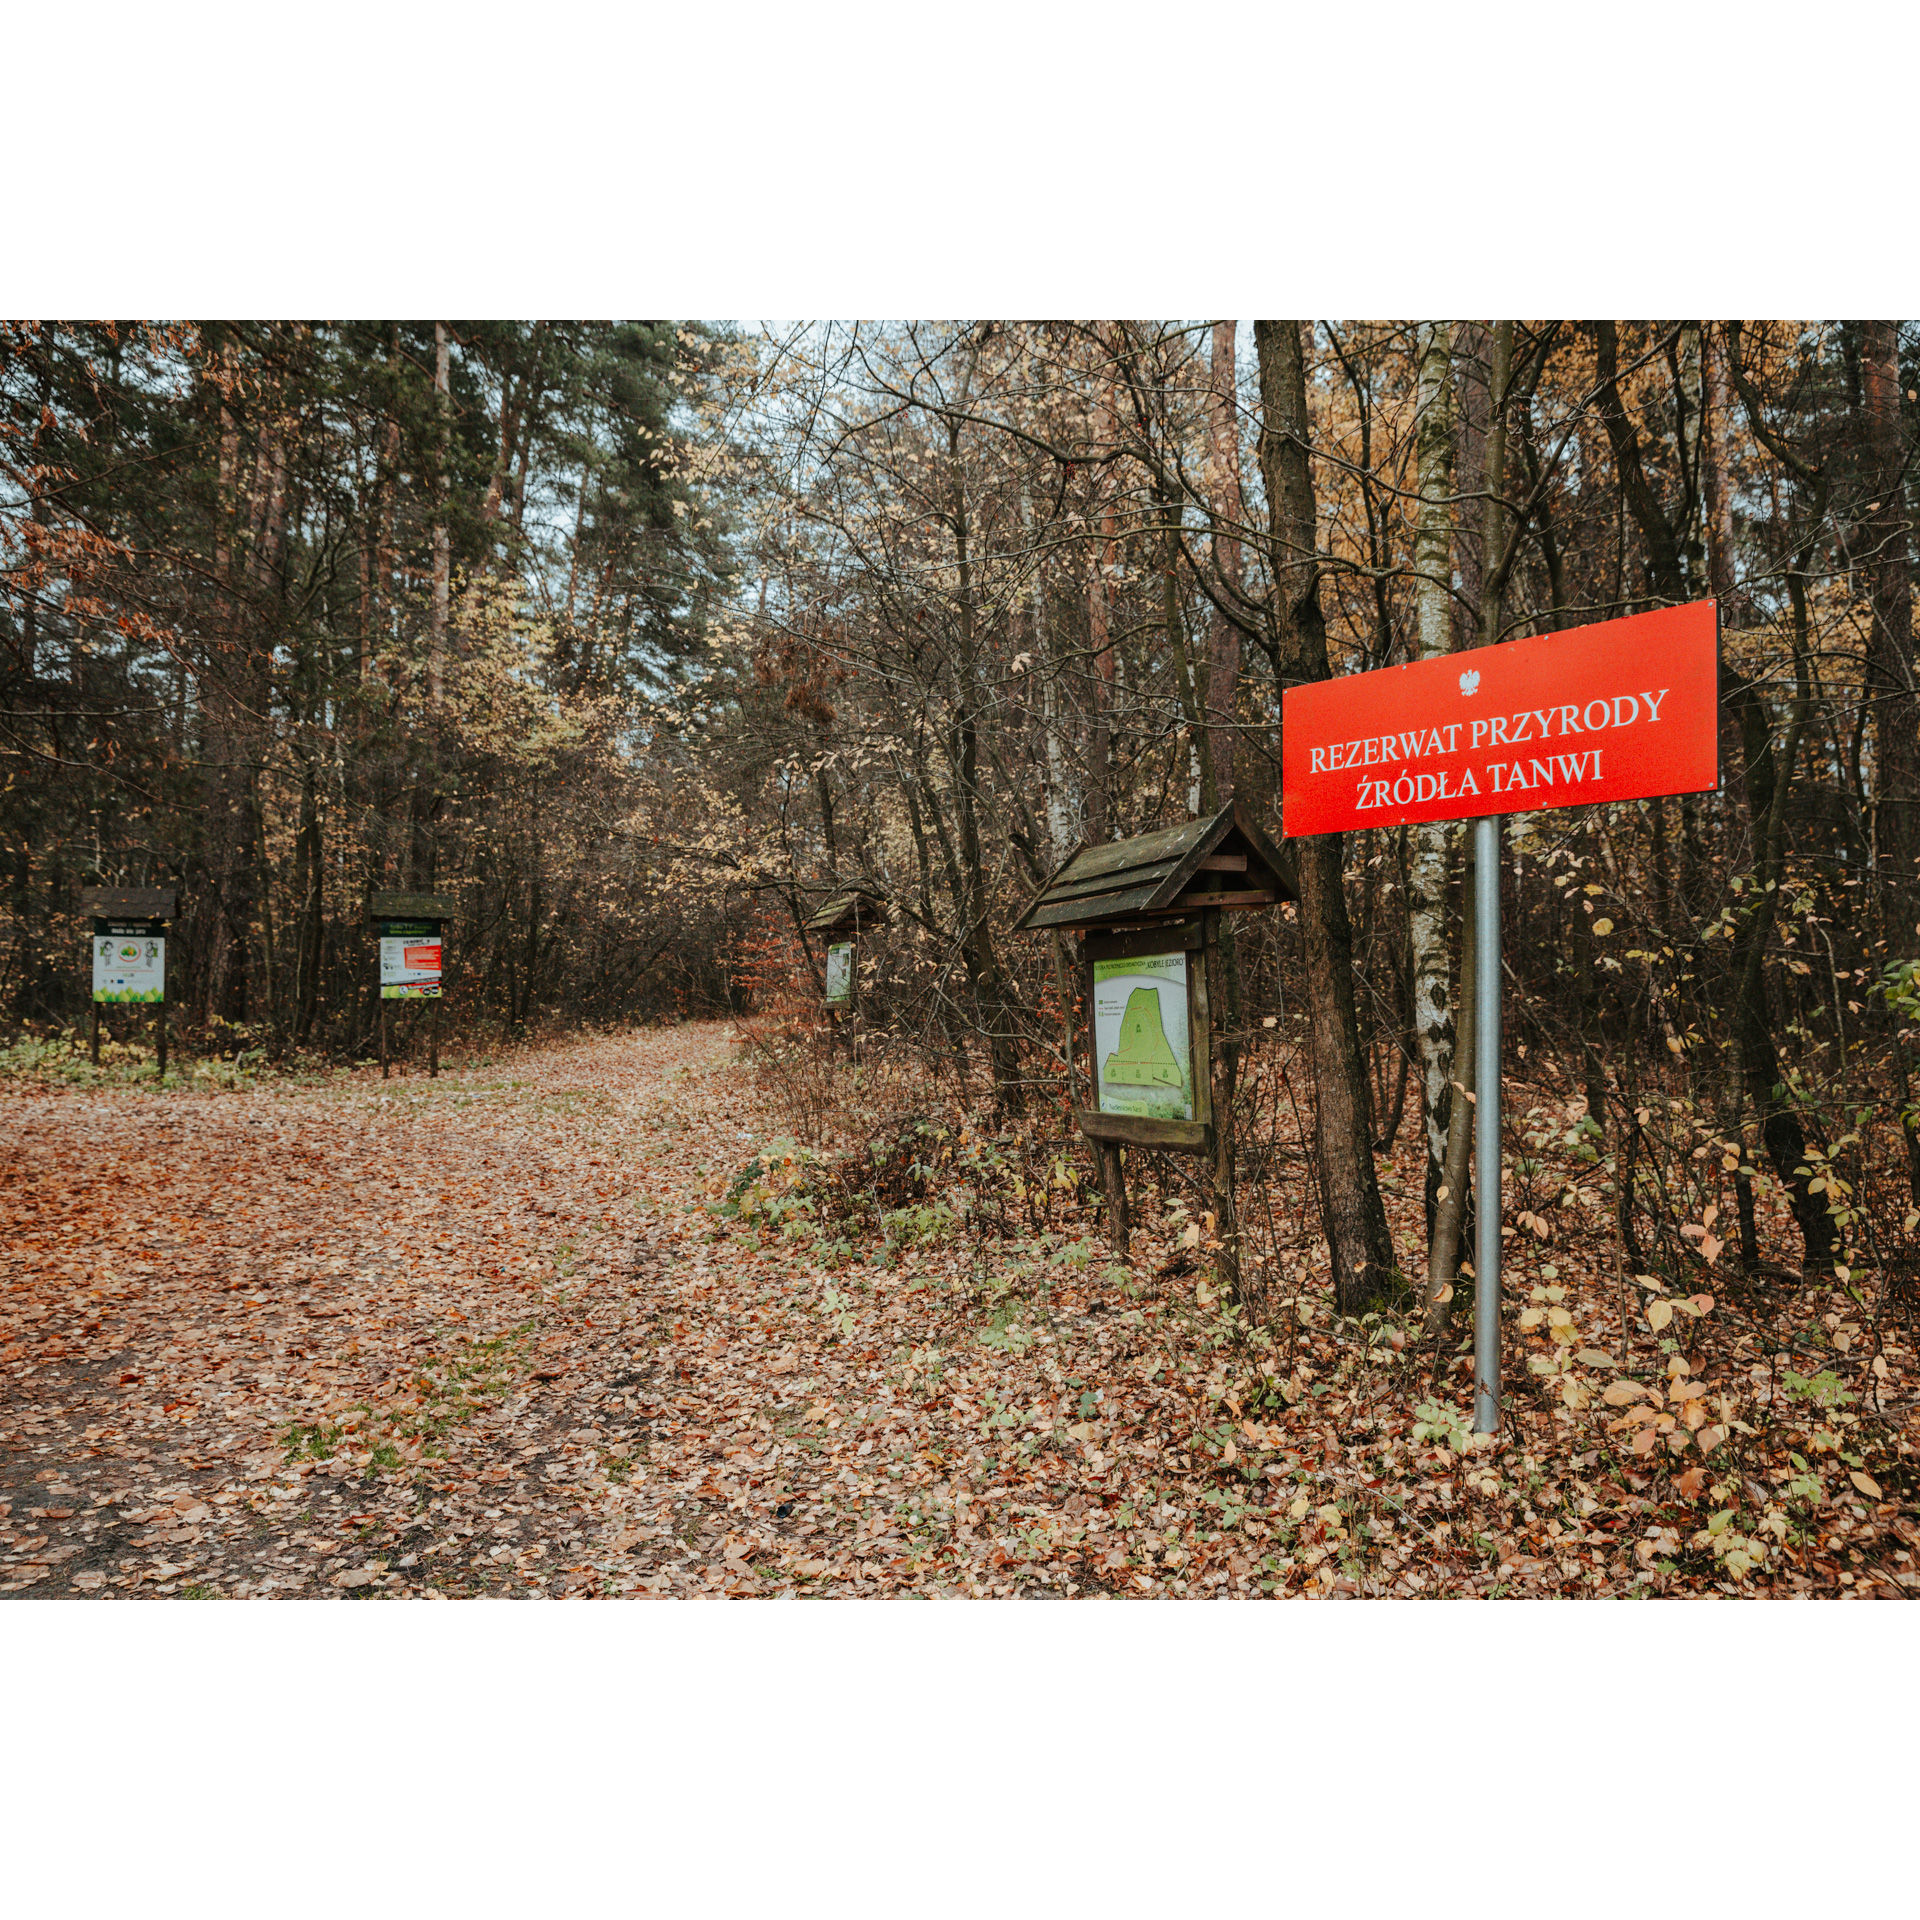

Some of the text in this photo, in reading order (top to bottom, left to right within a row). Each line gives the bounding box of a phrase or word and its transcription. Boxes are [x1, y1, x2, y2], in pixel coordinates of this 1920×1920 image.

[1309, 689, 1670, 774] REZERWAT PRZYRODY
[1354, 749, 1605, 810] ŹRÓDŁA TANWI
